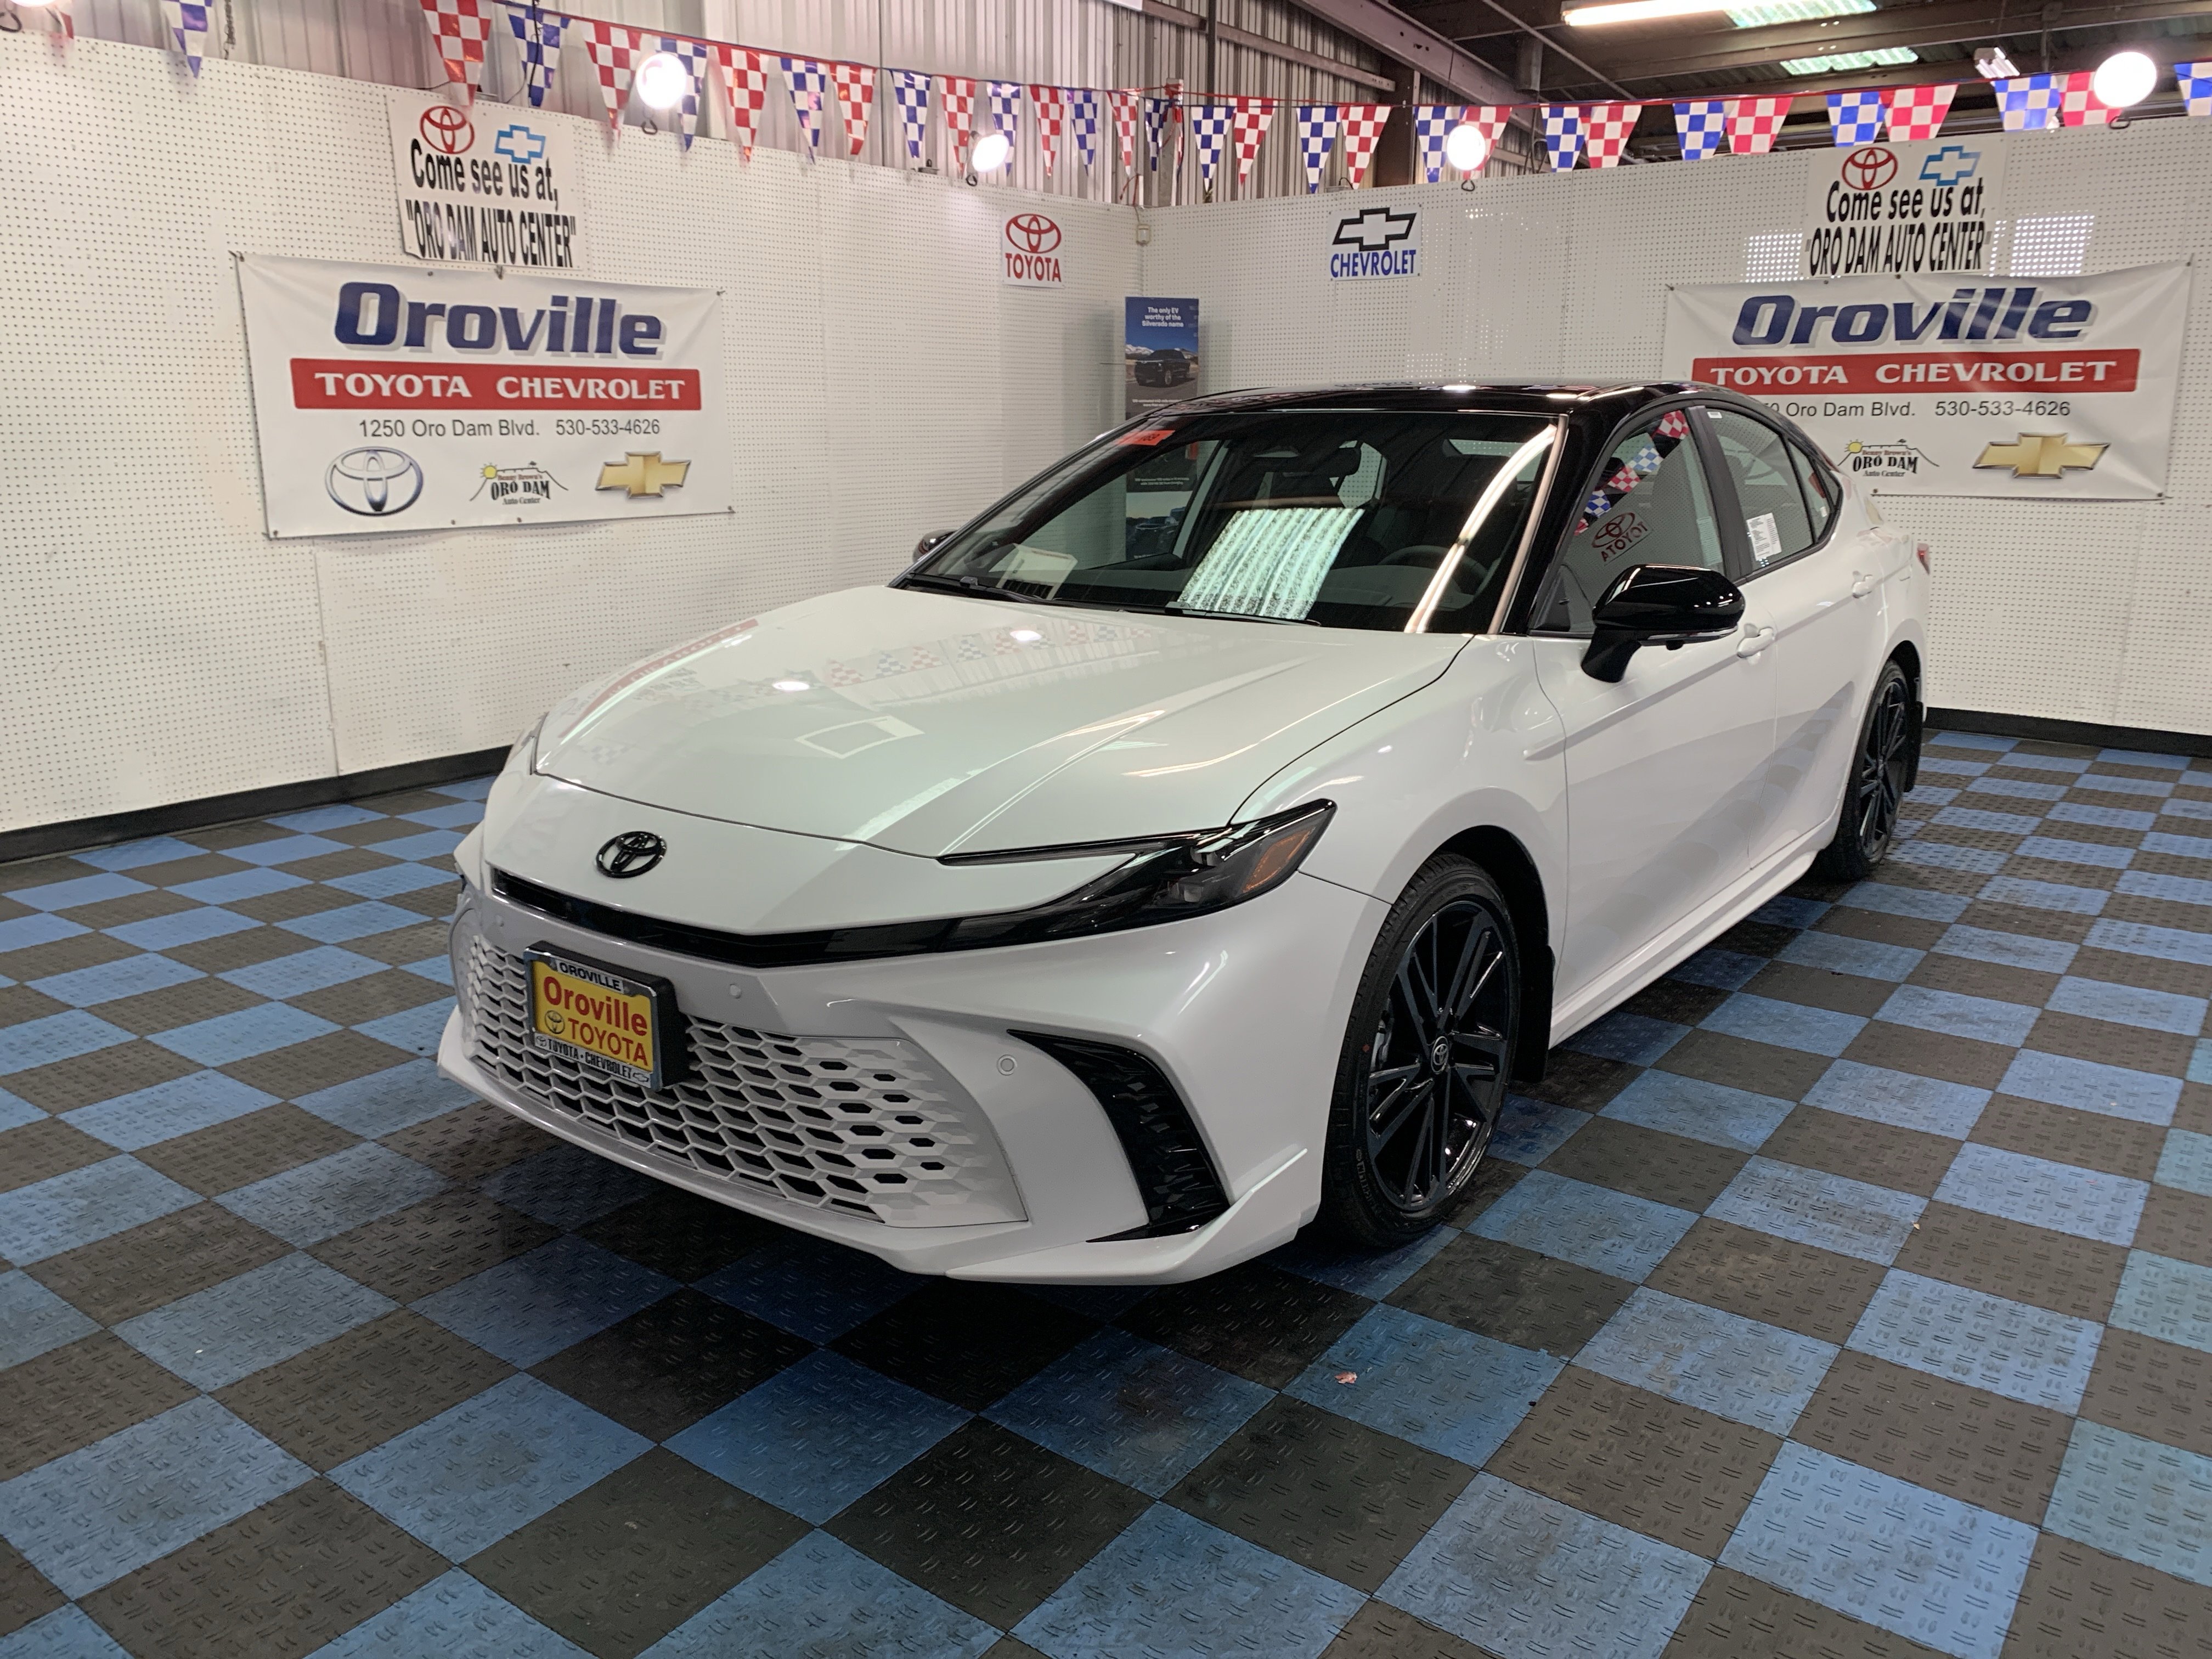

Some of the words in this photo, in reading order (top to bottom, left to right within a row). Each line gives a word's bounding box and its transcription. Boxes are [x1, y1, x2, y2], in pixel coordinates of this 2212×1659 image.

[411, 138, 465, 192] Come
[471, 159, 503, 196] see
[508, 163, 529, 199] us
[535, 156, 558, 212] at,
[1826, 180, 1882, 222] Come
[1888, 189, 1923, 219] see
[1931, 187, 1954, 217] us
[1961, 177, 1985, 218] at,
[405, 199, 444, 259] "ORO
[446, 204, 478, 261] DAM
[481, 207, 516, 264] AUTO
[520, 210, 576, 268] CENTER"
[1844, 225, 1881, 273] DAM
[1883, 222, 1926, 273] AUTO
[1005, 253, 1062, 282] TOYOTA
[1330, 250, 1417, 278] CHEVROLET
[334, 281, 663, 356] Oroville
[1732, 287, 2094, 345] Oroville
[314, 373, 472, 398] TOYOTA
[496, 376, 686, 399] CHEVROLET
[1710, 366, 1849, 385] TOYOTA
[1875, 361, 2117, 383] CHEVROLET
[1786, 402, 1817, 416] Oro
[1824, 402, 1864, 416] Dam
[1871, 402, 1916, 416] Blvd.
[1935, 401, 2071, 416] 530-533-4626
[359, 419, 405, 437] 1250
[412, 419, 446, 437] Oro
[452, 419, 492, 436] Dam
[498, 419, 540, 436] Blvd.
[556, 419, 661, 436] 530-533-4626
[1853, 456, 1882, 472] ORO
[1888, 456, 1918, 474] DAM
[491, 481, 518, 500] ORO
[523, 481, 551, 499] DAM
[560, 962, 621, 991] OROVILLE
[544, 976, 647, 1036] Oroville
[548, 1039, 579, 1059] TOYOTA
[585, 1052, 632, 1079] CHEVROLET
[568, 1018, 648, 1066] TOYOTA
